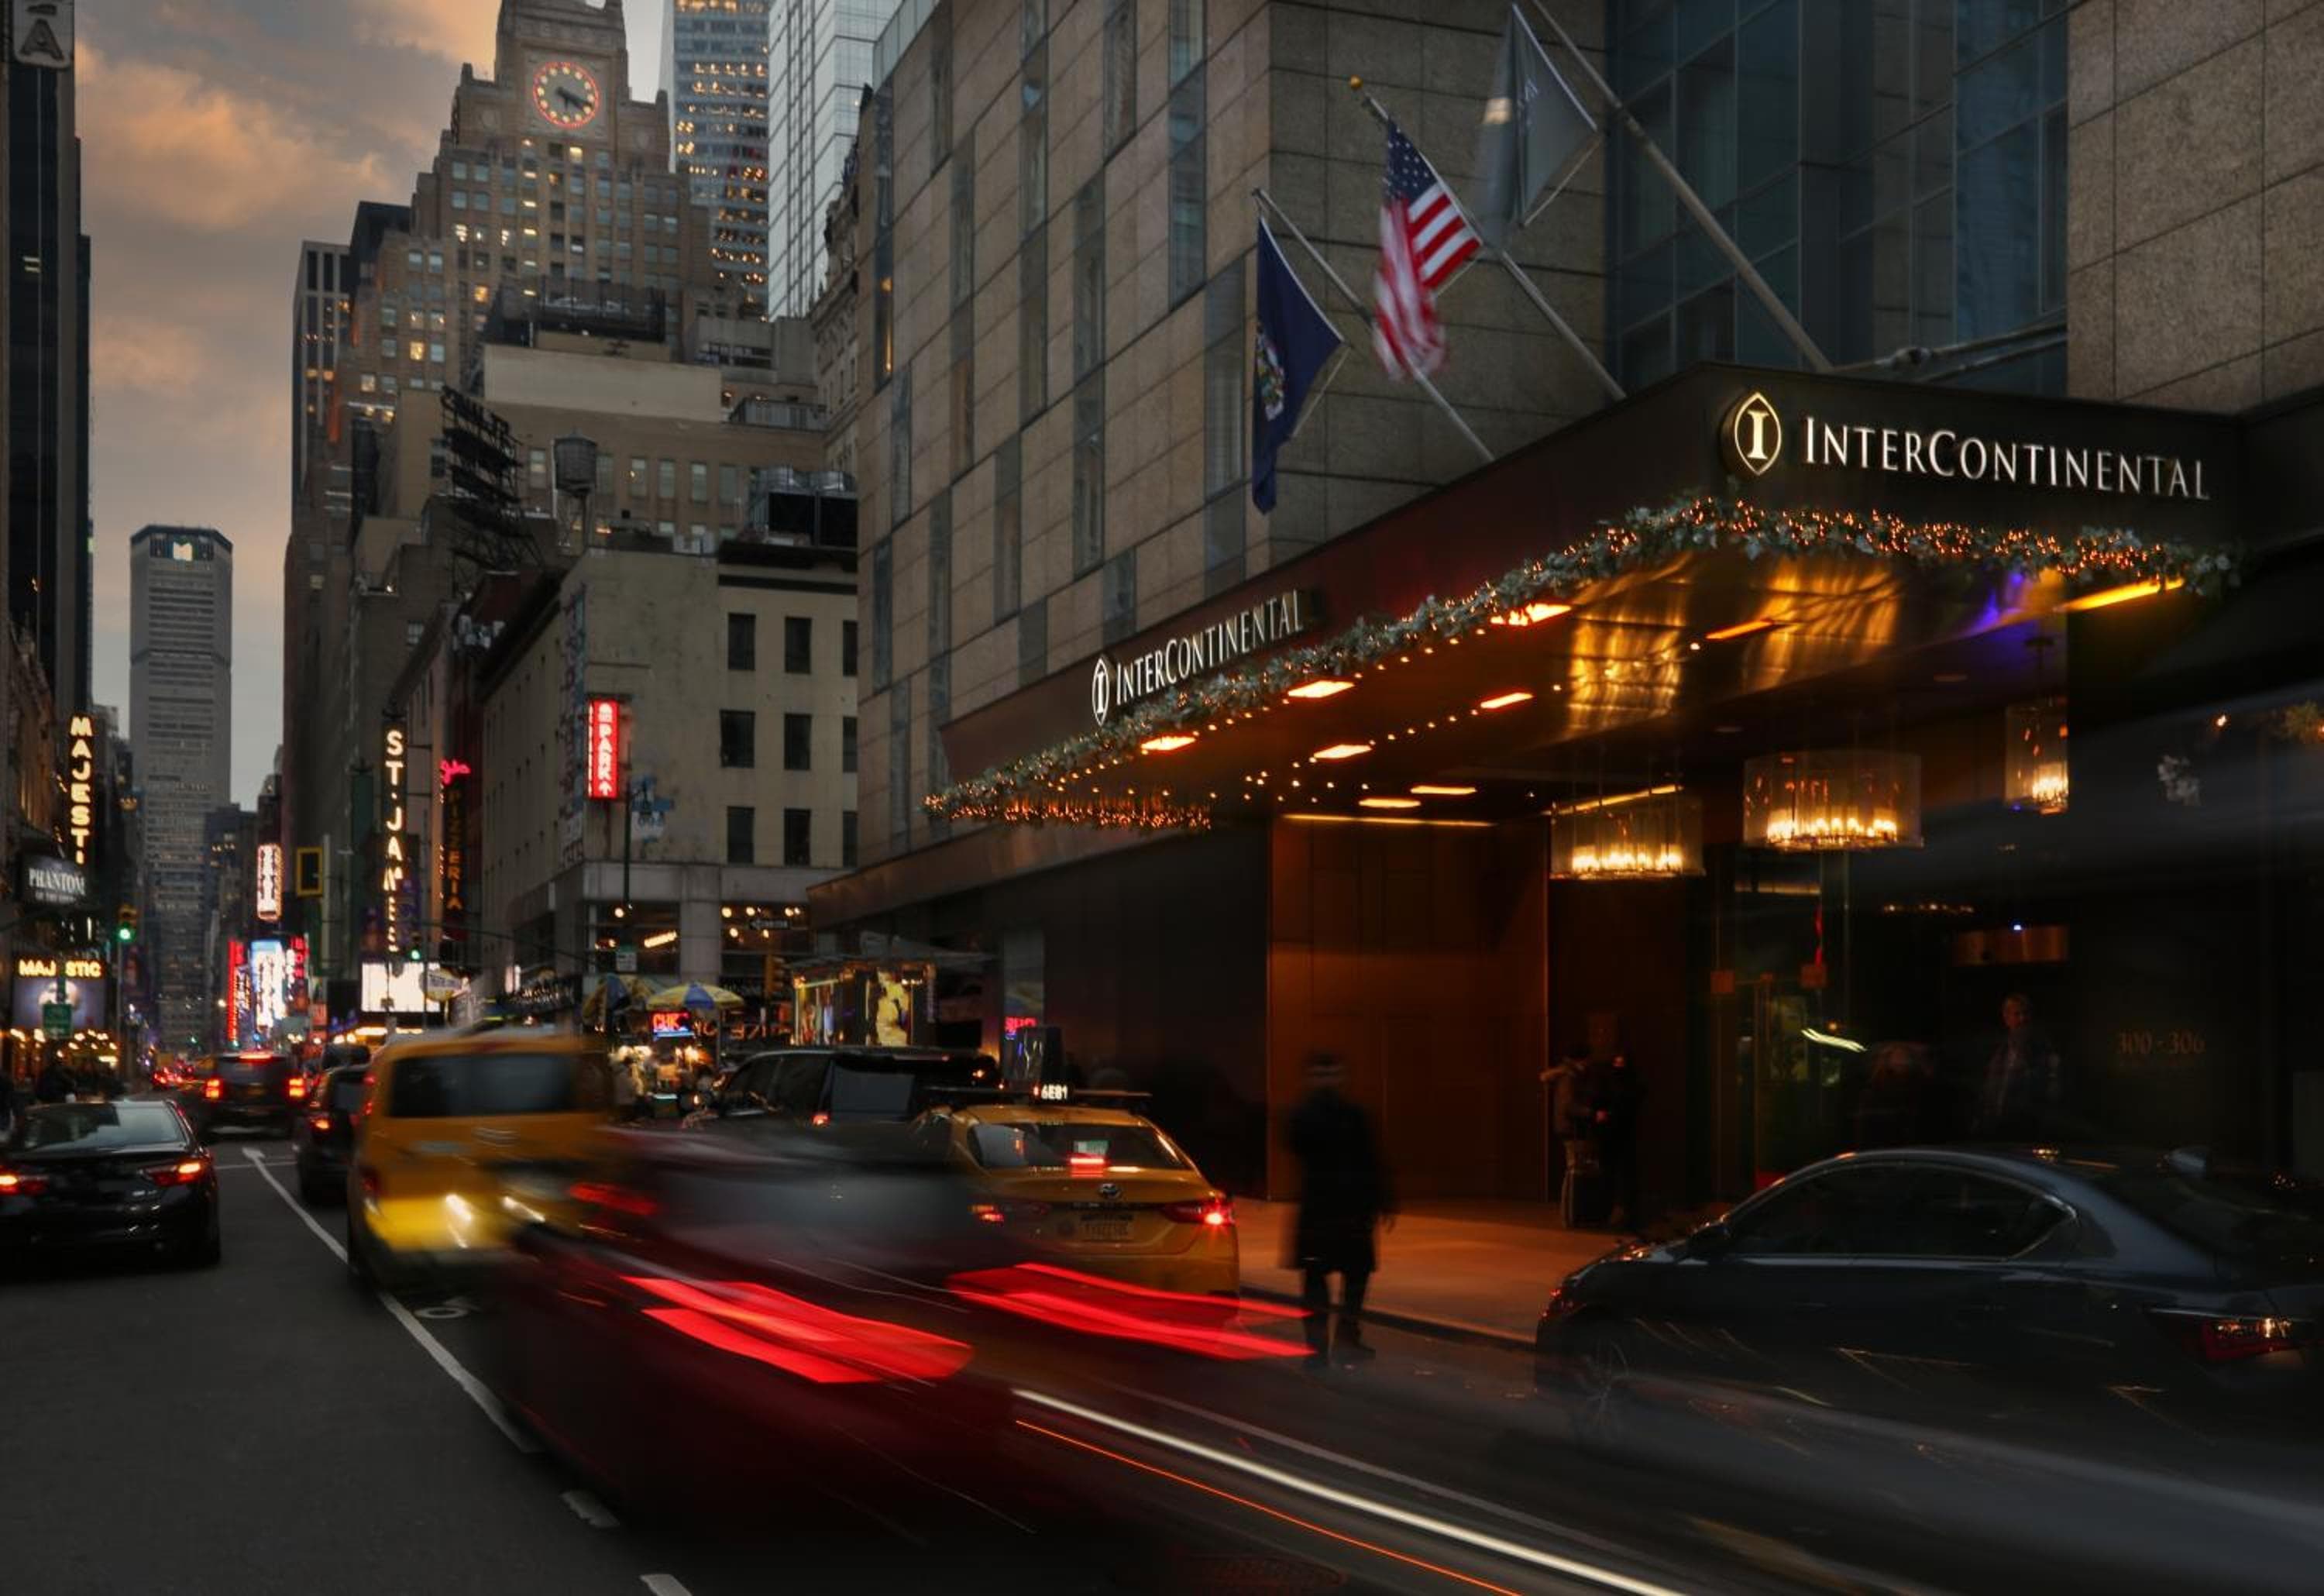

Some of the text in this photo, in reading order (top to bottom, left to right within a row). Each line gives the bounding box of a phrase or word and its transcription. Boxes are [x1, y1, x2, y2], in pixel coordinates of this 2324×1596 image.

[1803, 414, 2211, 501] INTERCONTINENTAL
[1116, 589, 1303, 706] INTERCONTINENTAL
[70, 716, 92, 865] MAJESTI
[598, 724, 613, 781] PARK
[19, 959, 101, 977] MAJSTIC
